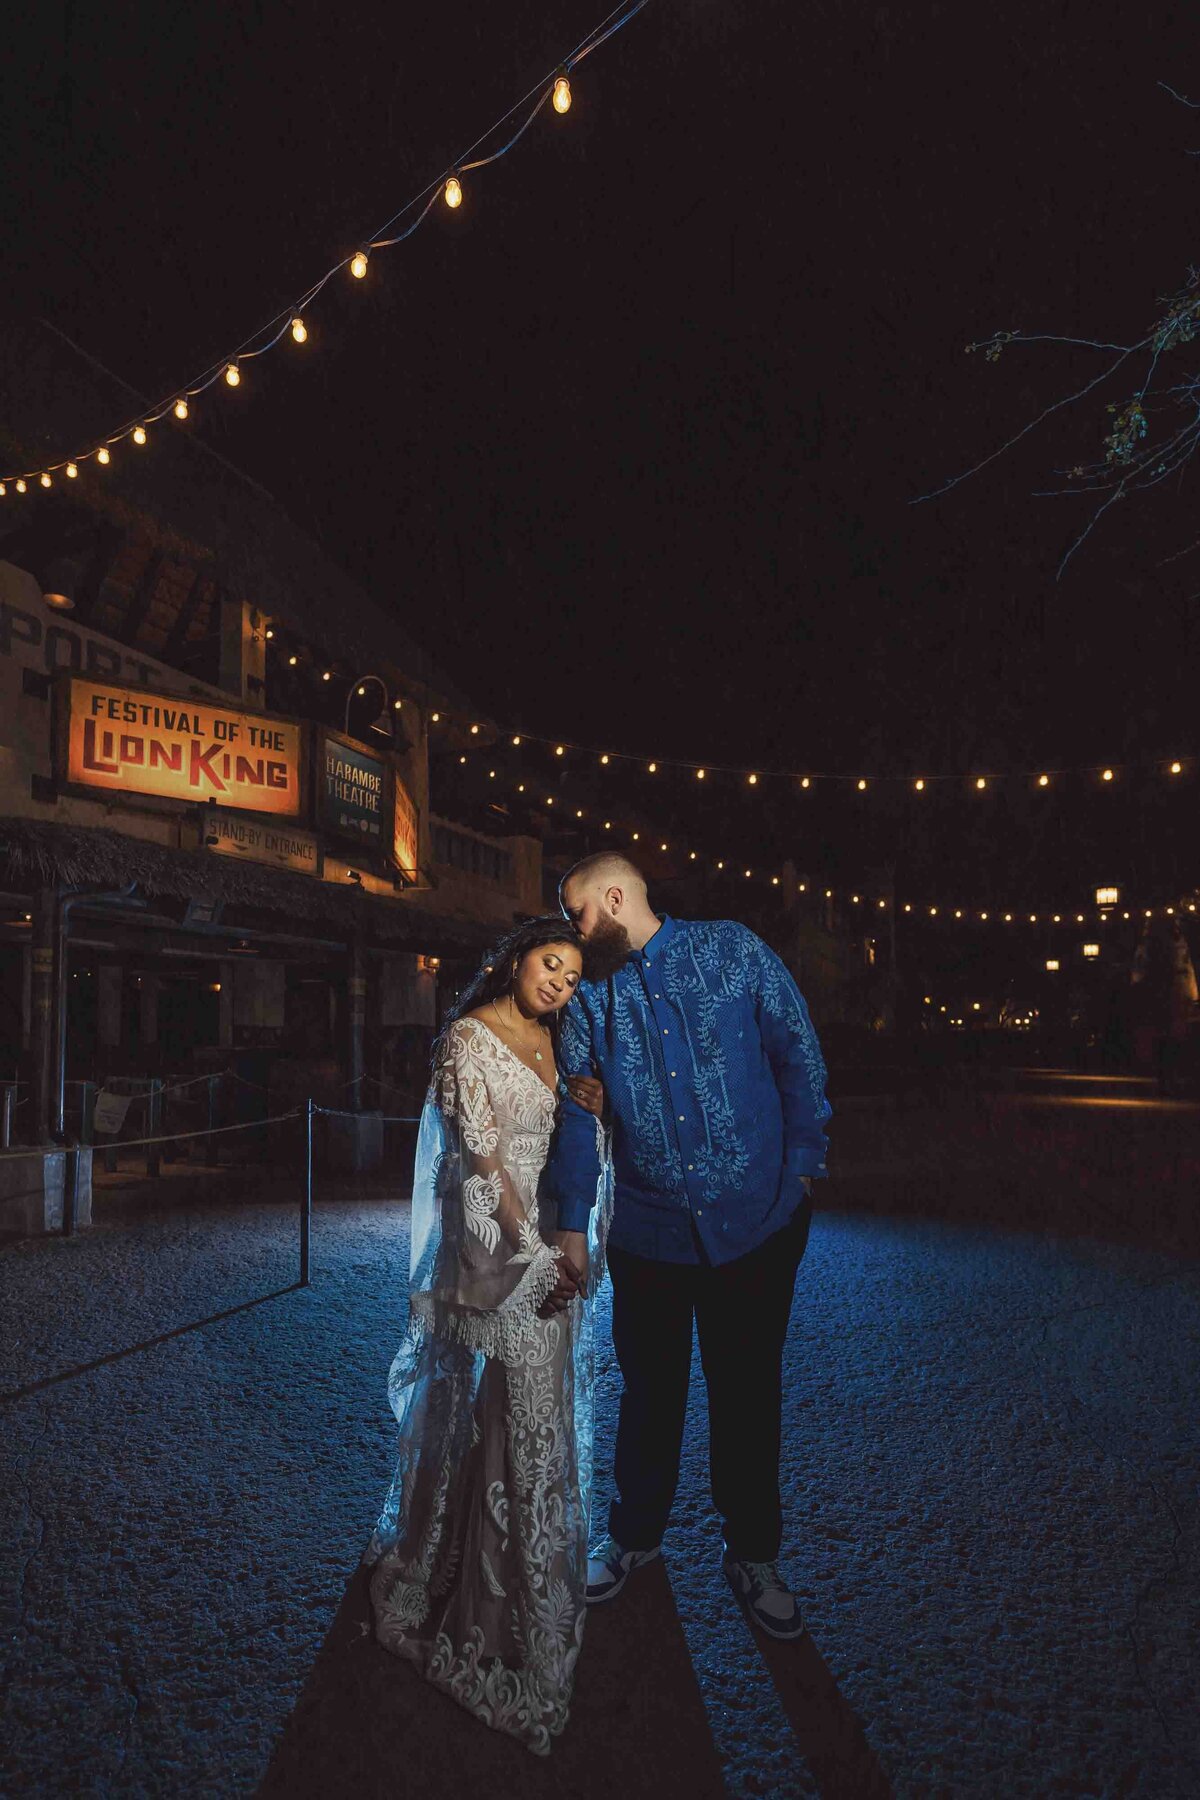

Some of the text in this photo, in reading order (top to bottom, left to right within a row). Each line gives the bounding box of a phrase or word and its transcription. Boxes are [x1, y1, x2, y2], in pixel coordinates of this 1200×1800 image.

[0, 601, 160, 684] PORT
[92, 695, 285, 752] FESTIVAL OF THE
[83, 718, 288, 791] LION KING
[326, 756, 382, 794] HARAMBE
[326, 775, 381, 814] THEATRE
[209, 819, 313, 861] STAND-BY ENTRANCE
